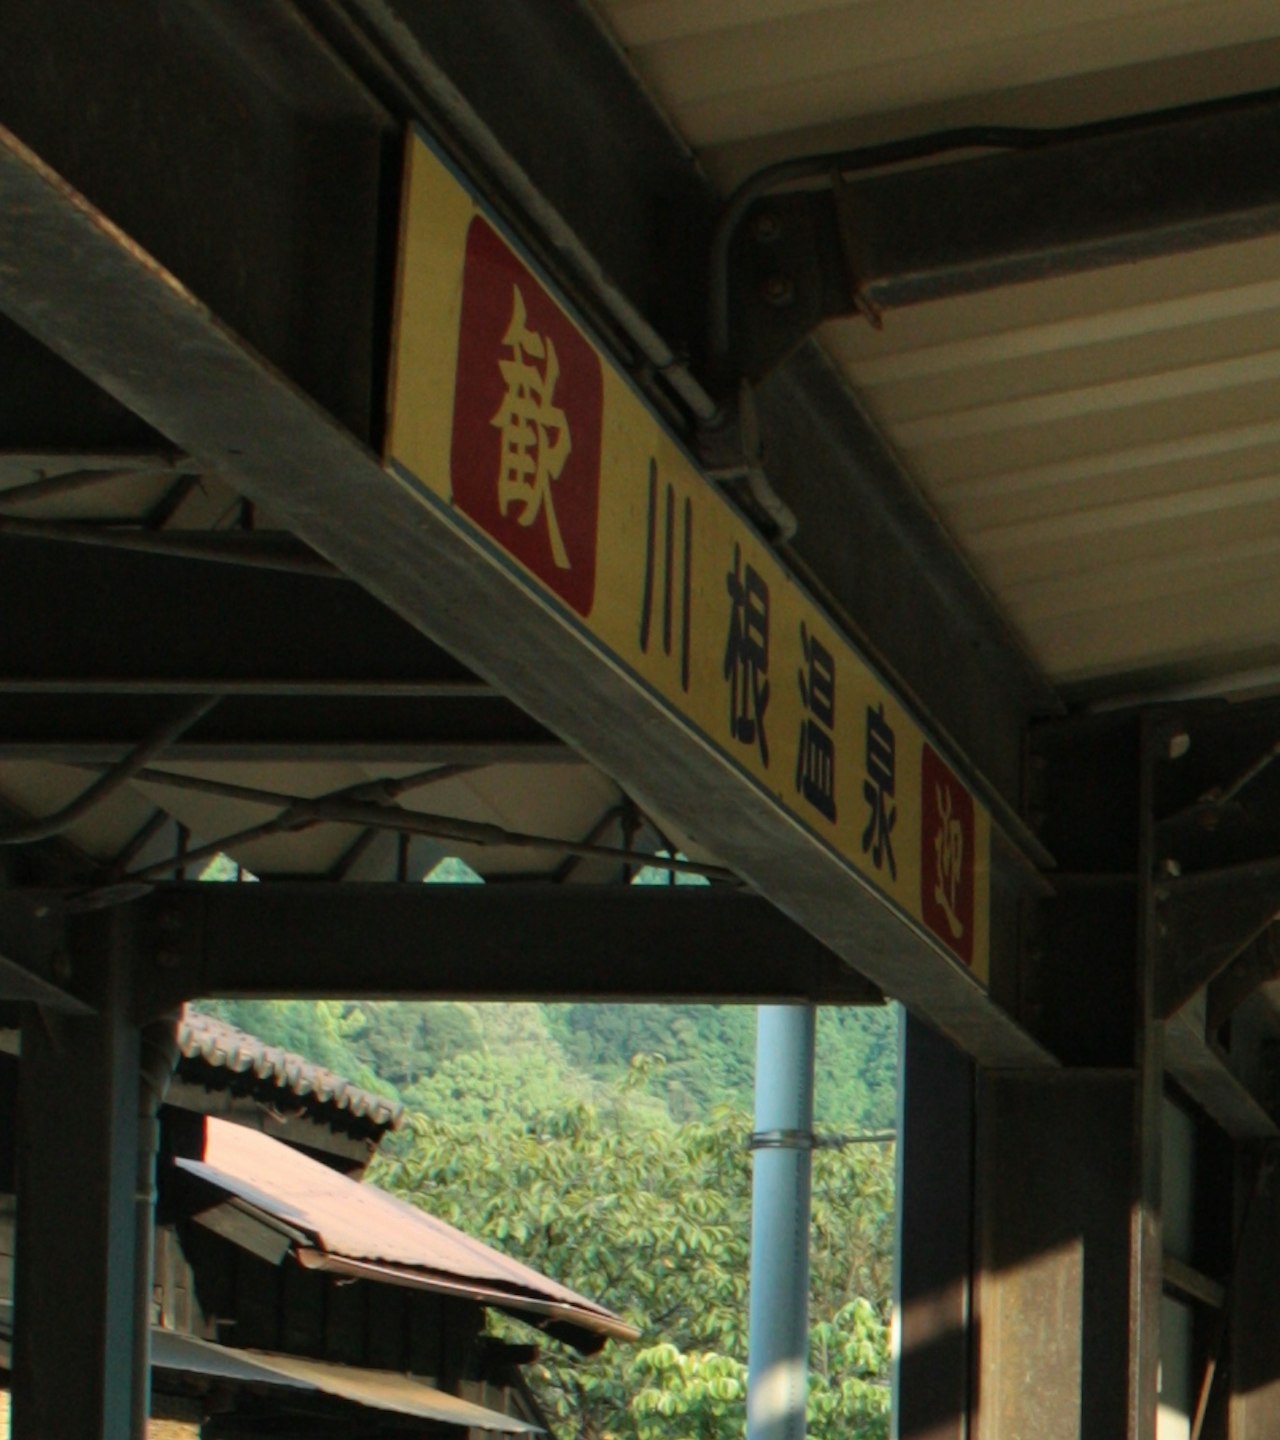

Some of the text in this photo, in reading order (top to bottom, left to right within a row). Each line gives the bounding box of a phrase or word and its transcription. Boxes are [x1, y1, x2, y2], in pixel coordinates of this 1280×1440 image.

[487, 282, 965, 940] 歓 川根温泉 迎
